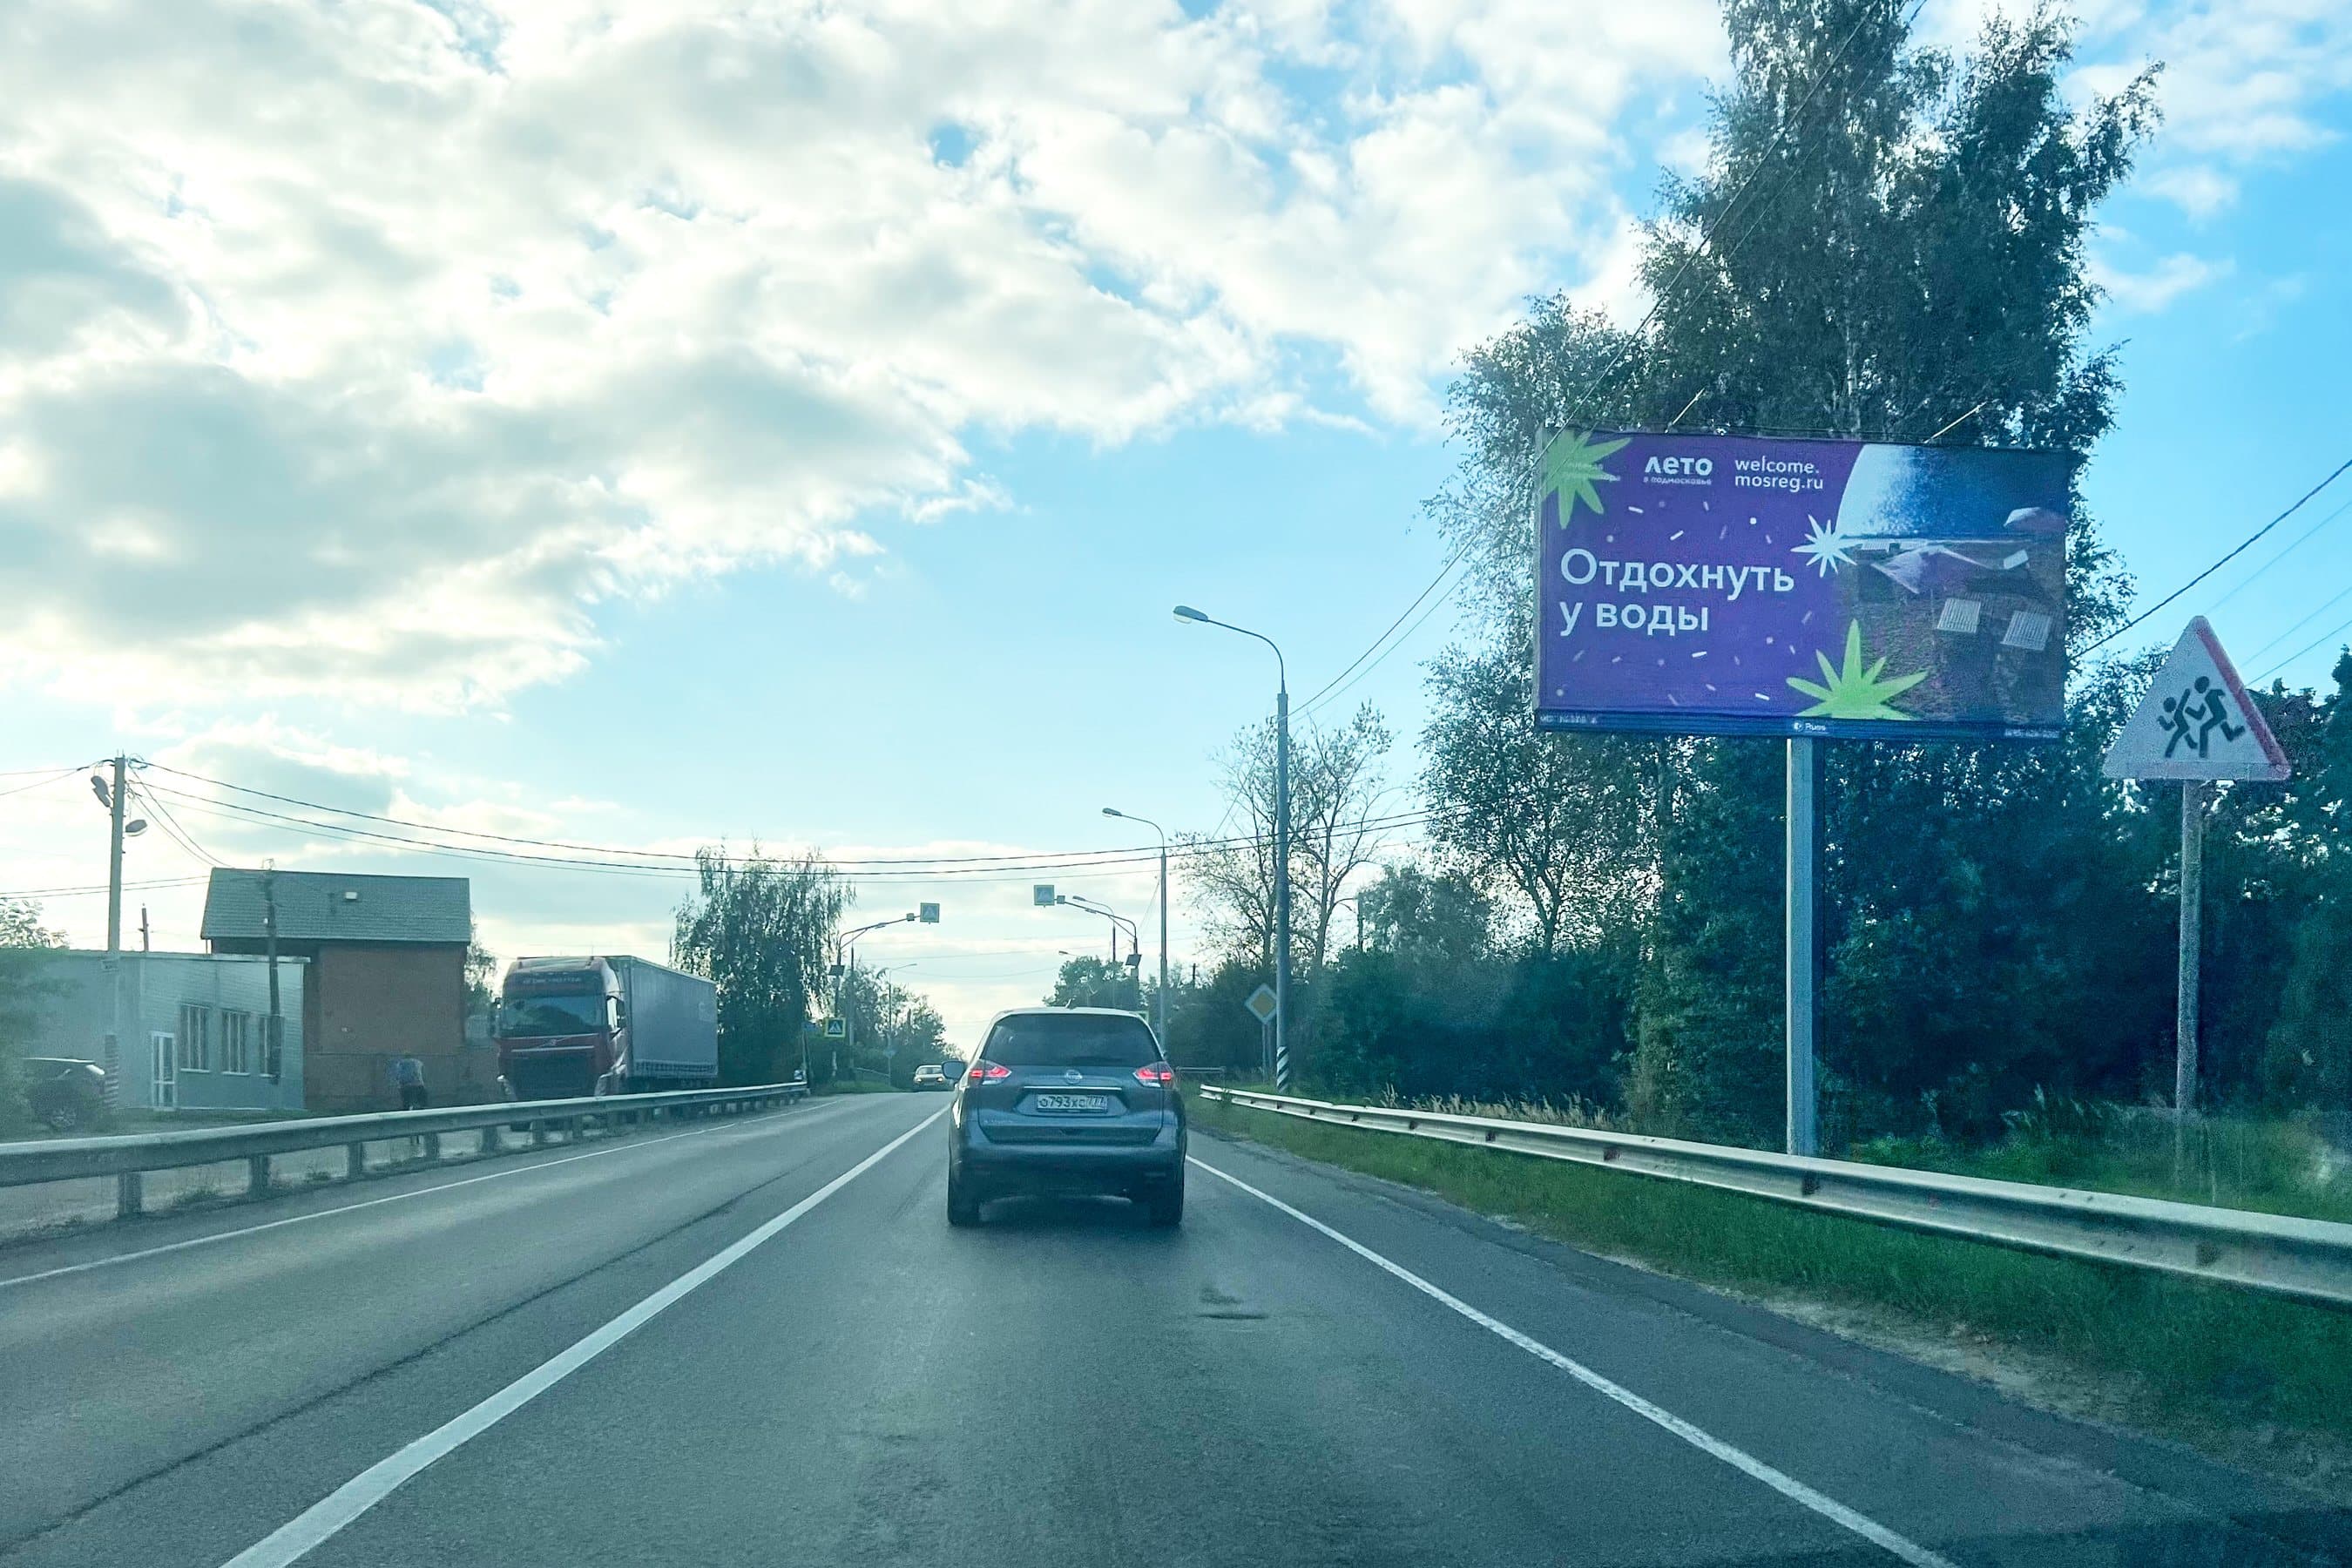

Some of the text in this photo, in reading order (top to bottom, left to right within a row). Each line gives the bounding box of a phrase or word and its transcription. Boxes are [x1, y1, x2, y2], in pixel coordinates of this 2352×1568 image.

[1734, 455, 1820, 474] welcome.
[1734, 473, 1824, 493] mosreg.ru
[1560, 548, 1795, 601] Отдохнуть
[1559, 601, 1709, 637] у воды
